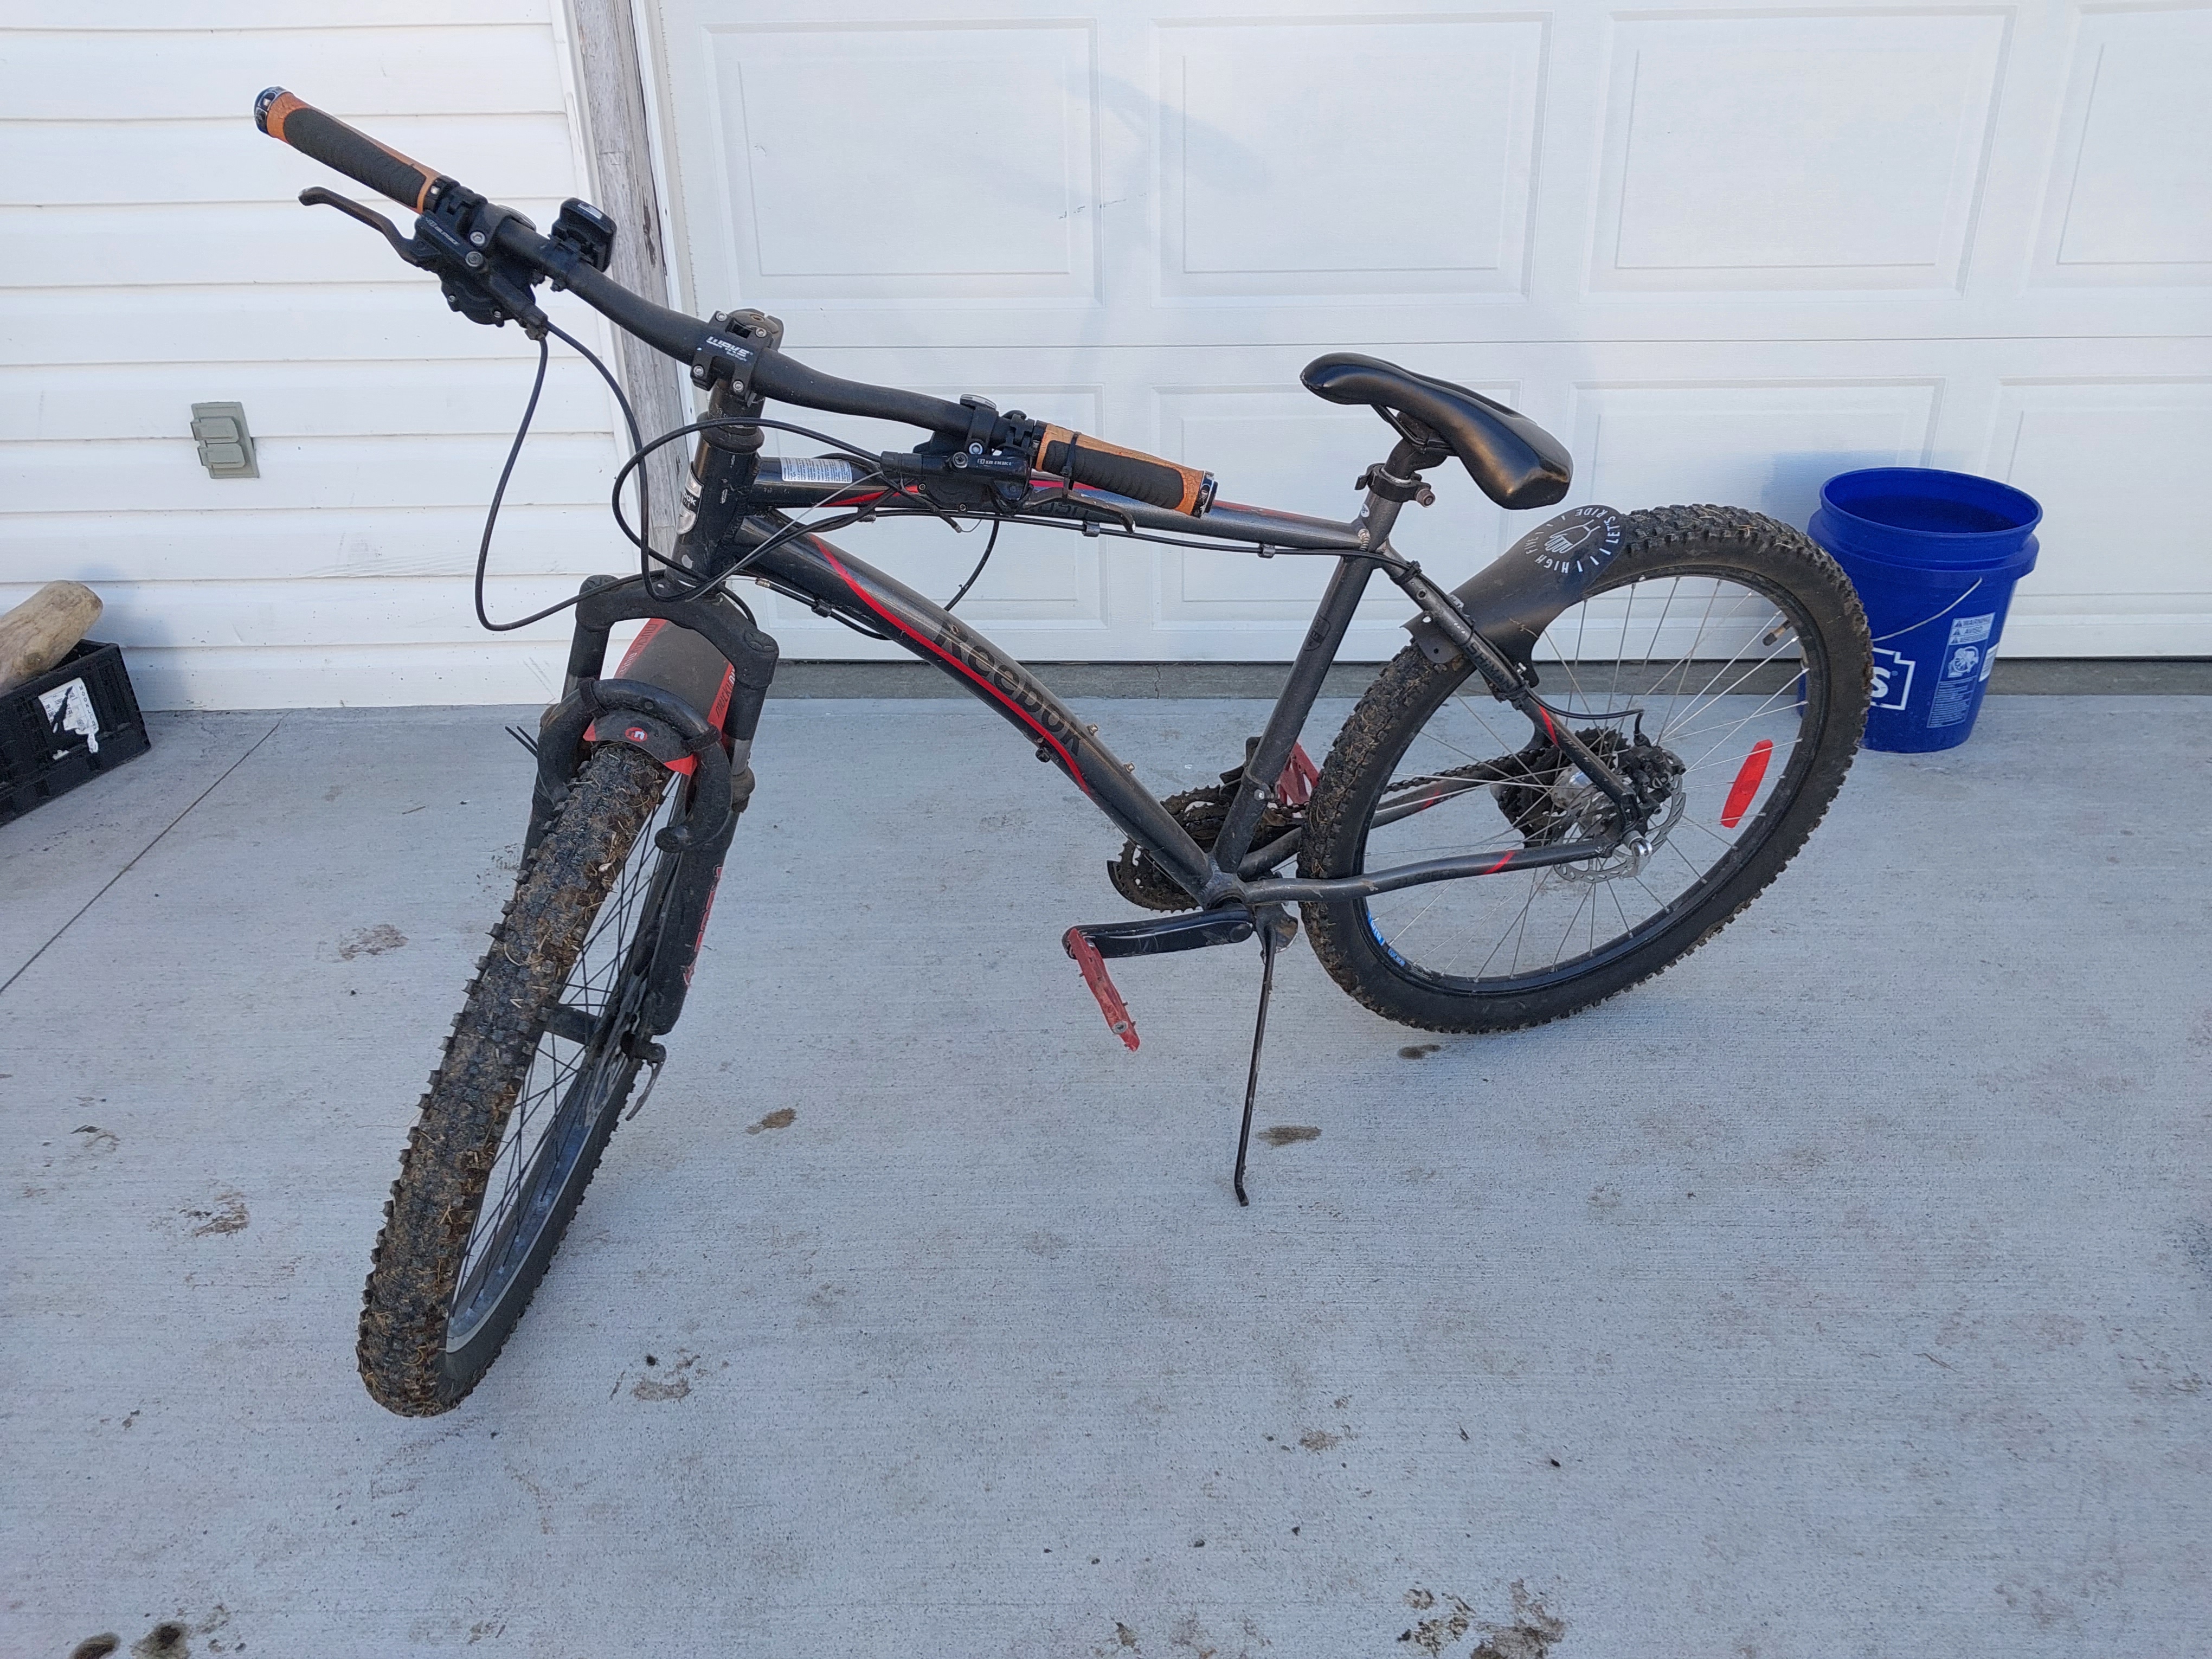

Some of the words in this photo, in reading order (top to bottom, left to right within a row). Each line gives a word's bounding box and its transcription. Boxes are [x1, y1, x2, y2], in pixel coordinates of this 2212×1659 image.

[1574, 507, 1609, 519] RIDE
[1603, 516, 1621, 544] LET'S
[1524, 536, 1539, 554] FIVE
[1534, 554, 1570, 574] HIGH
[1465, 642, 1516, 692] SHIMAN
[933, 620, 1080, 756] Reebok
